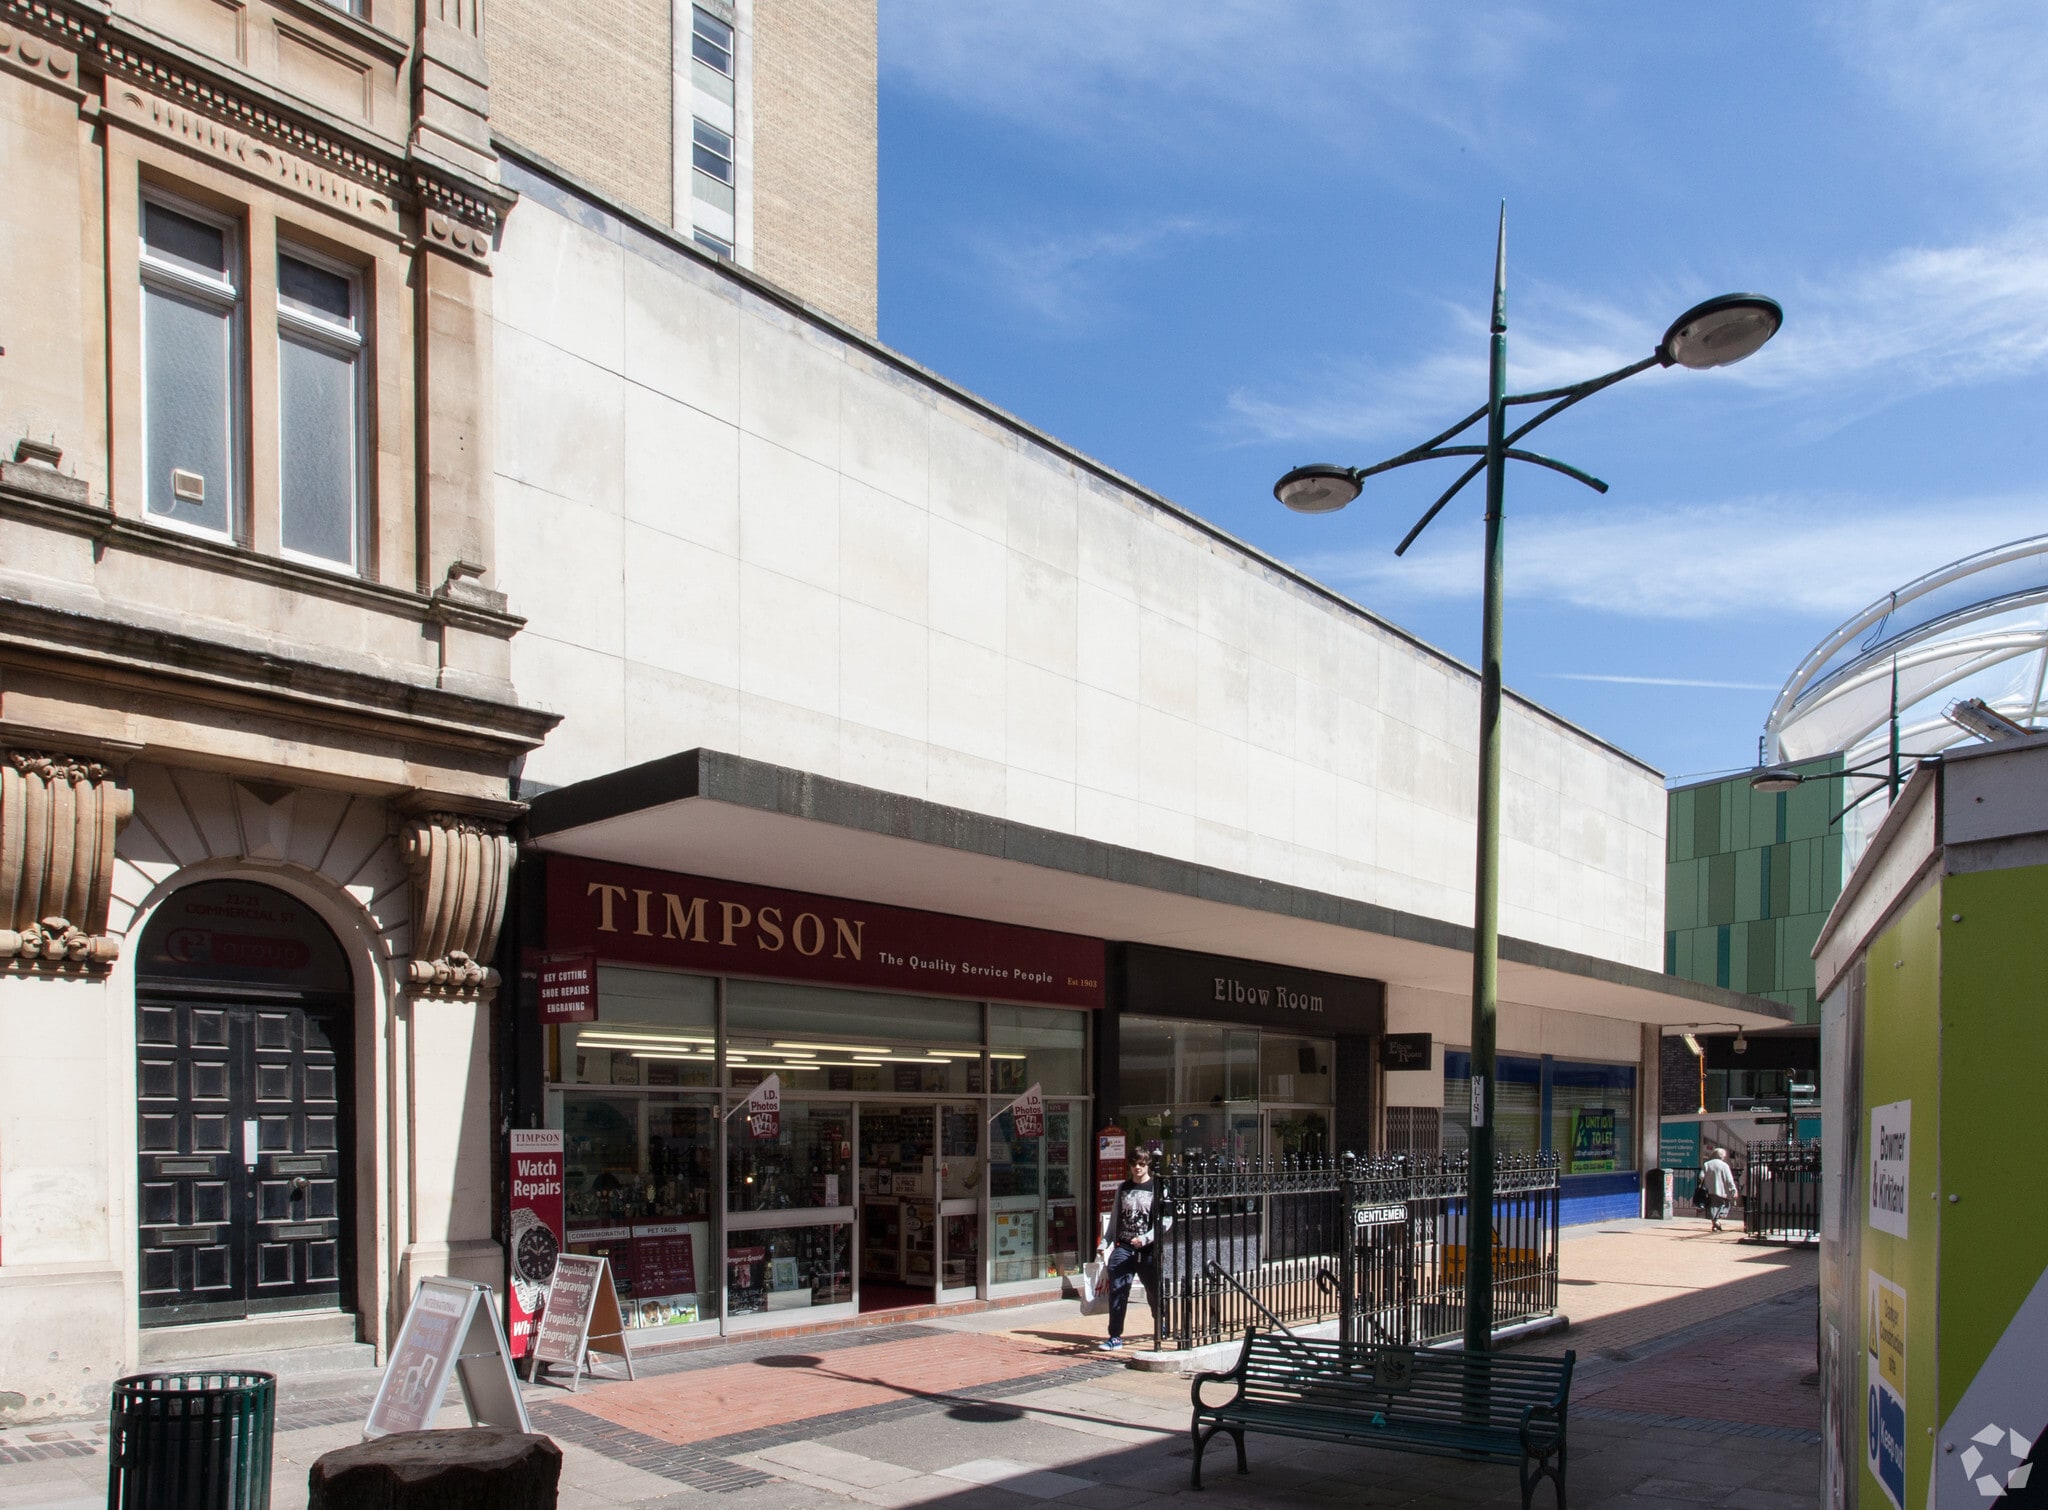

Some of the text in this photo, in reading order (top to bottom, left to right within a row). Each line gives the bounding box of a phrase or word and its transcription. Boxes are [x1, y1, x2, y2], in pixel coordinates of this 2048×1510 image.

[185, 903, 297, 924] COMMERCIAL ST
[587, 882, 866, 961] TIMPSON
[222, 941, 298, 963] group
[879, 952, 1053, 984] The Quality Service People
[543, 969, 588, 983] KEY CUTTING
[1067, 977, 1098, 989] Est 1903
[541, 985, 590, 999] SHOE REPAIRS
[1214, 978, 1323, 1012] Elbow Room
[547, 1001, 585, 1013] ENGRAVING
[763, 1090, 778, 1100] I.D.
[1026, 1096, 1041, 1106] I.D.
[750, 1101, 778, 1112] Photos
[1014, 1106, 1042, 1115] Photos
[1585, 1115, 1601, 1129] UNIT
[515, 1133, 560, 1143] TIMPSON
[1591, 1131, 1613, 1145] TO LET
[1880, 1125, 1905, 1161] Bowmer
[517, 1158, 557, 1177] Watch
[513, 1179, 561, 1200] Repairs
[1872, 1160, 1878, 1207] &
[1357, 1208, 1405, 1223] GENTLEMEN
[571, 1229, 626, 1240] COMMEMORATIVE
[558, 1261, 586, 1277] Trophies
[553, 1278, 590, 1293] Engraving
[545, 1311, 575, 1327] Trophies
[513, 1319, 542, 1337] While
[541, 1327, 579, 1344] Engraving
[1880, 1417, 1904, 1473] Keep out
